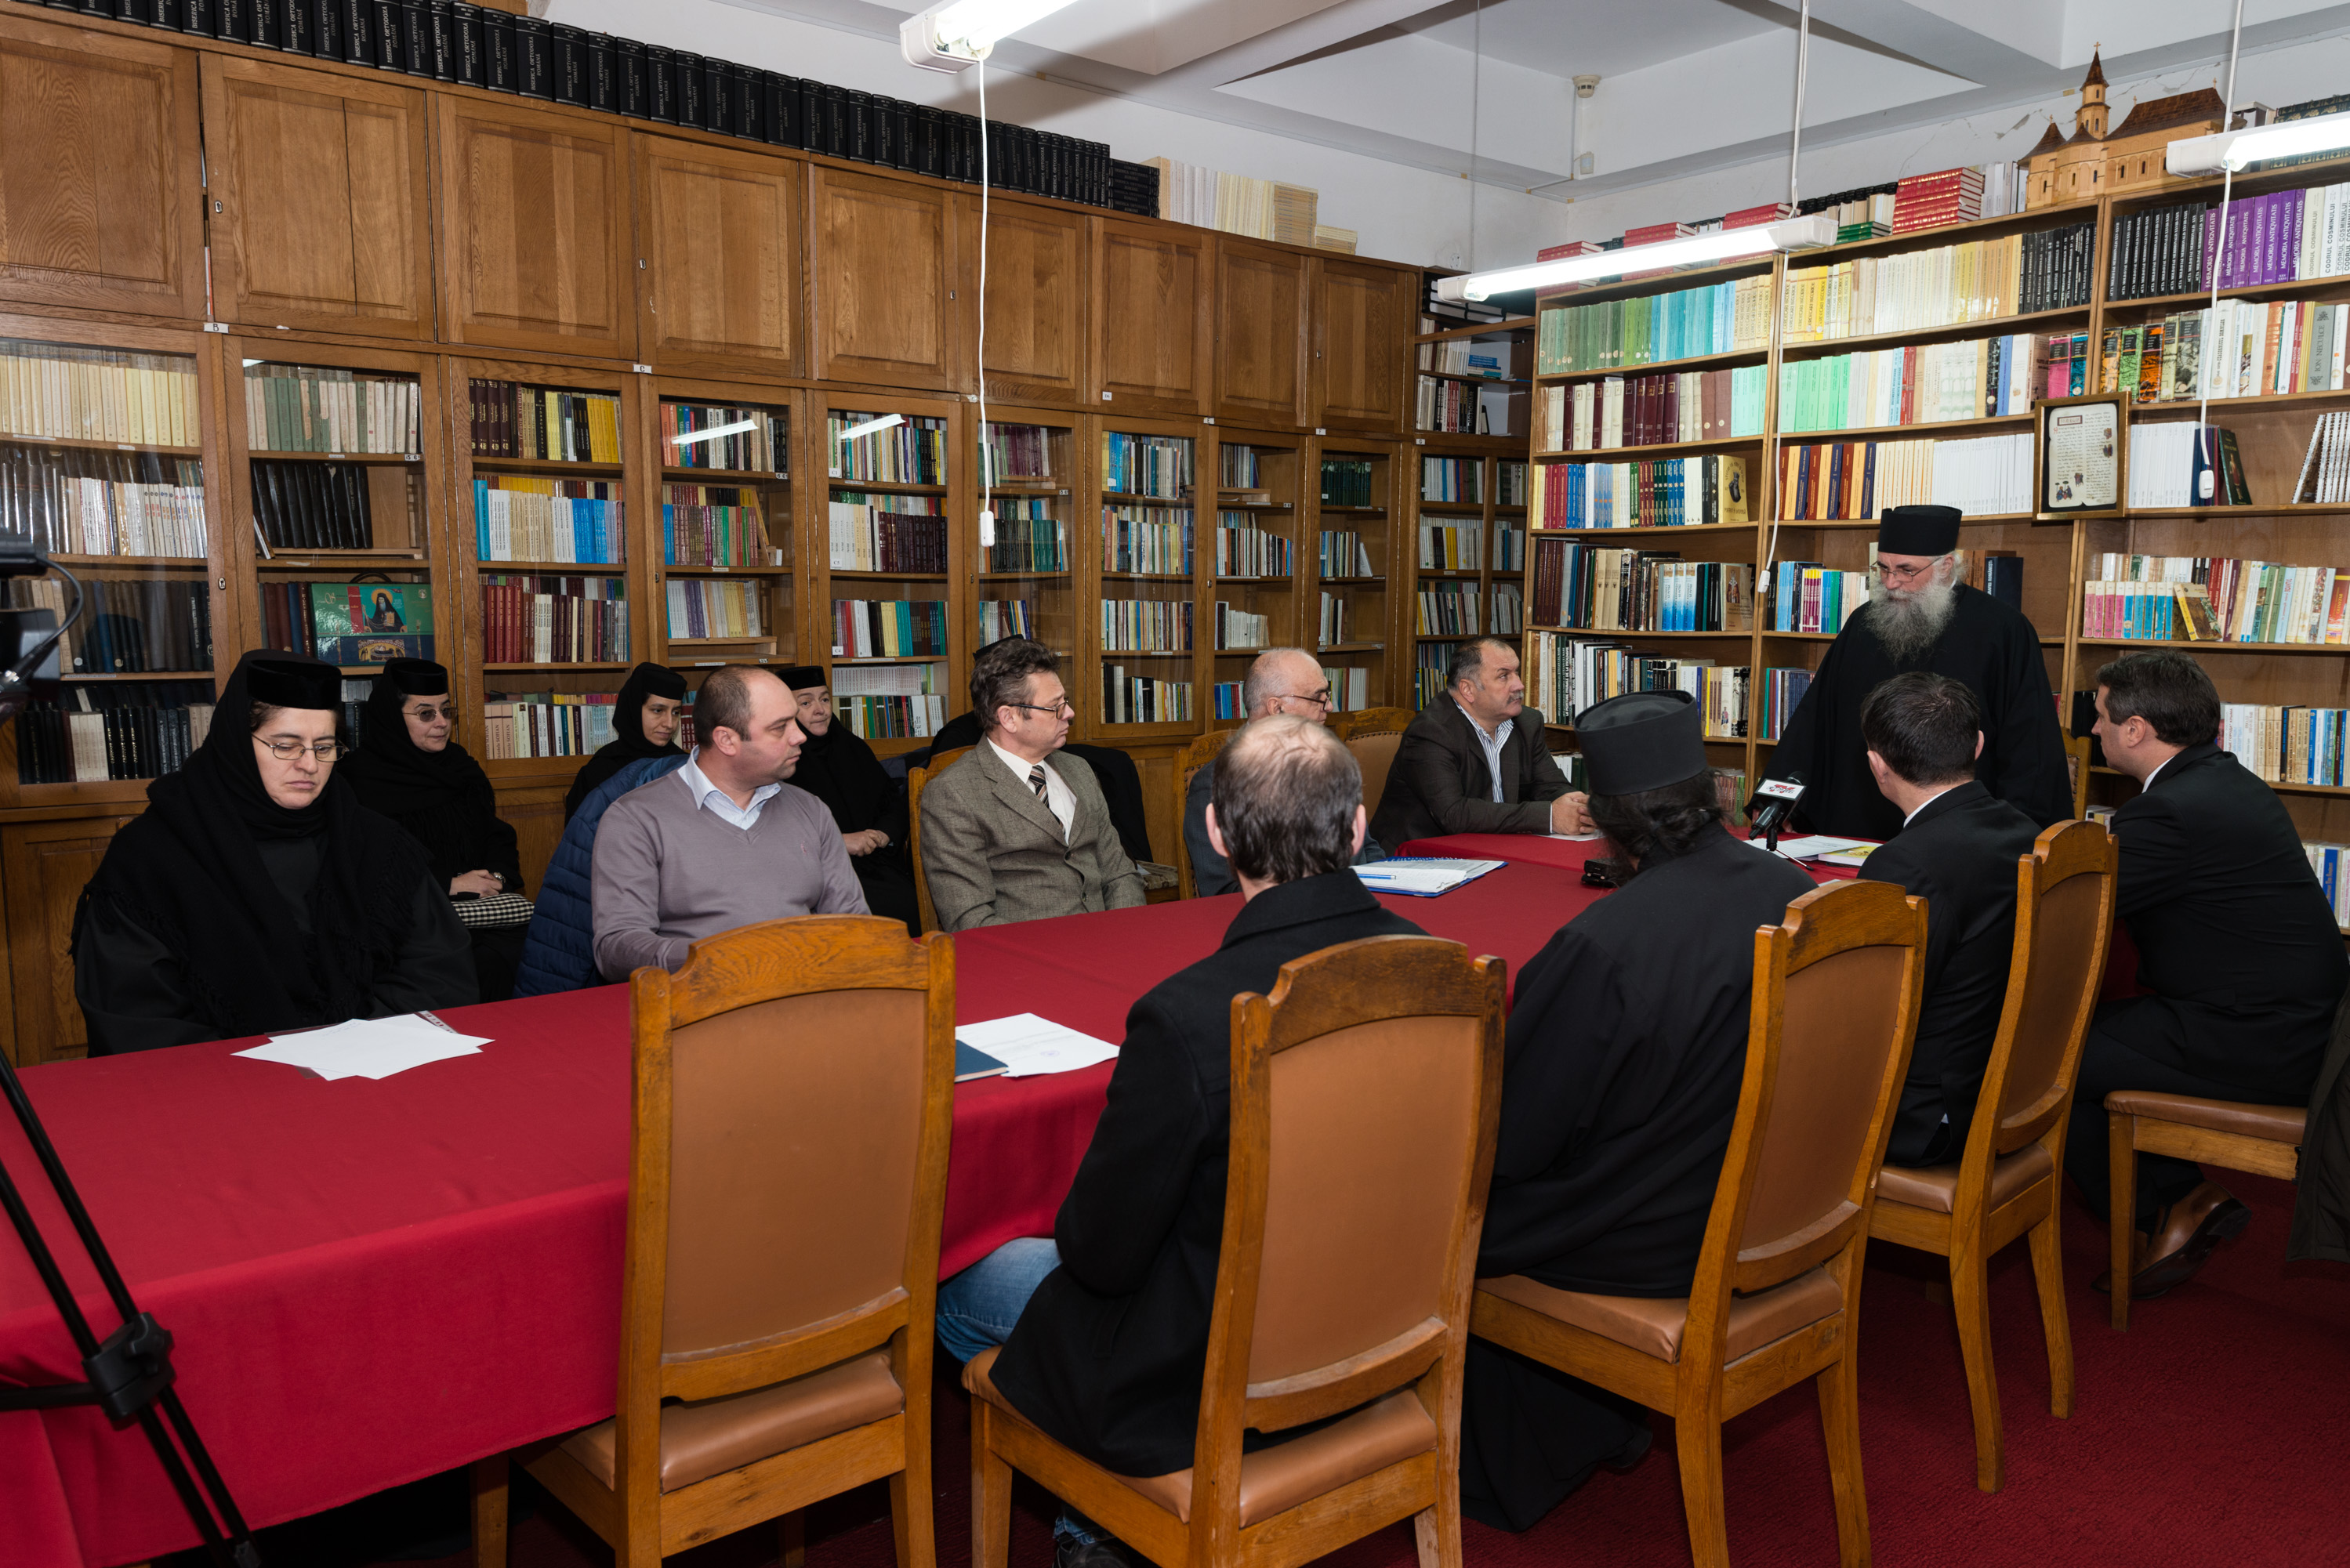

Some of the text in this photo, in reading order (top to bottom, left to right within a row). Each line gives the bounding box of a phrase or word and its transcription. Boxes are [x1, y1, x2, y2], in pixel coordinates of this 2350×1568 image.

[2207, 212, 2215, 252] ANTIQVITATIS
[2283, 201, 2291, 241] ANTIQVITATIS
[2294, 201, 2303, 239] ANTIQVITATIS
[2316, 325, 2325, 356] NECULCE
